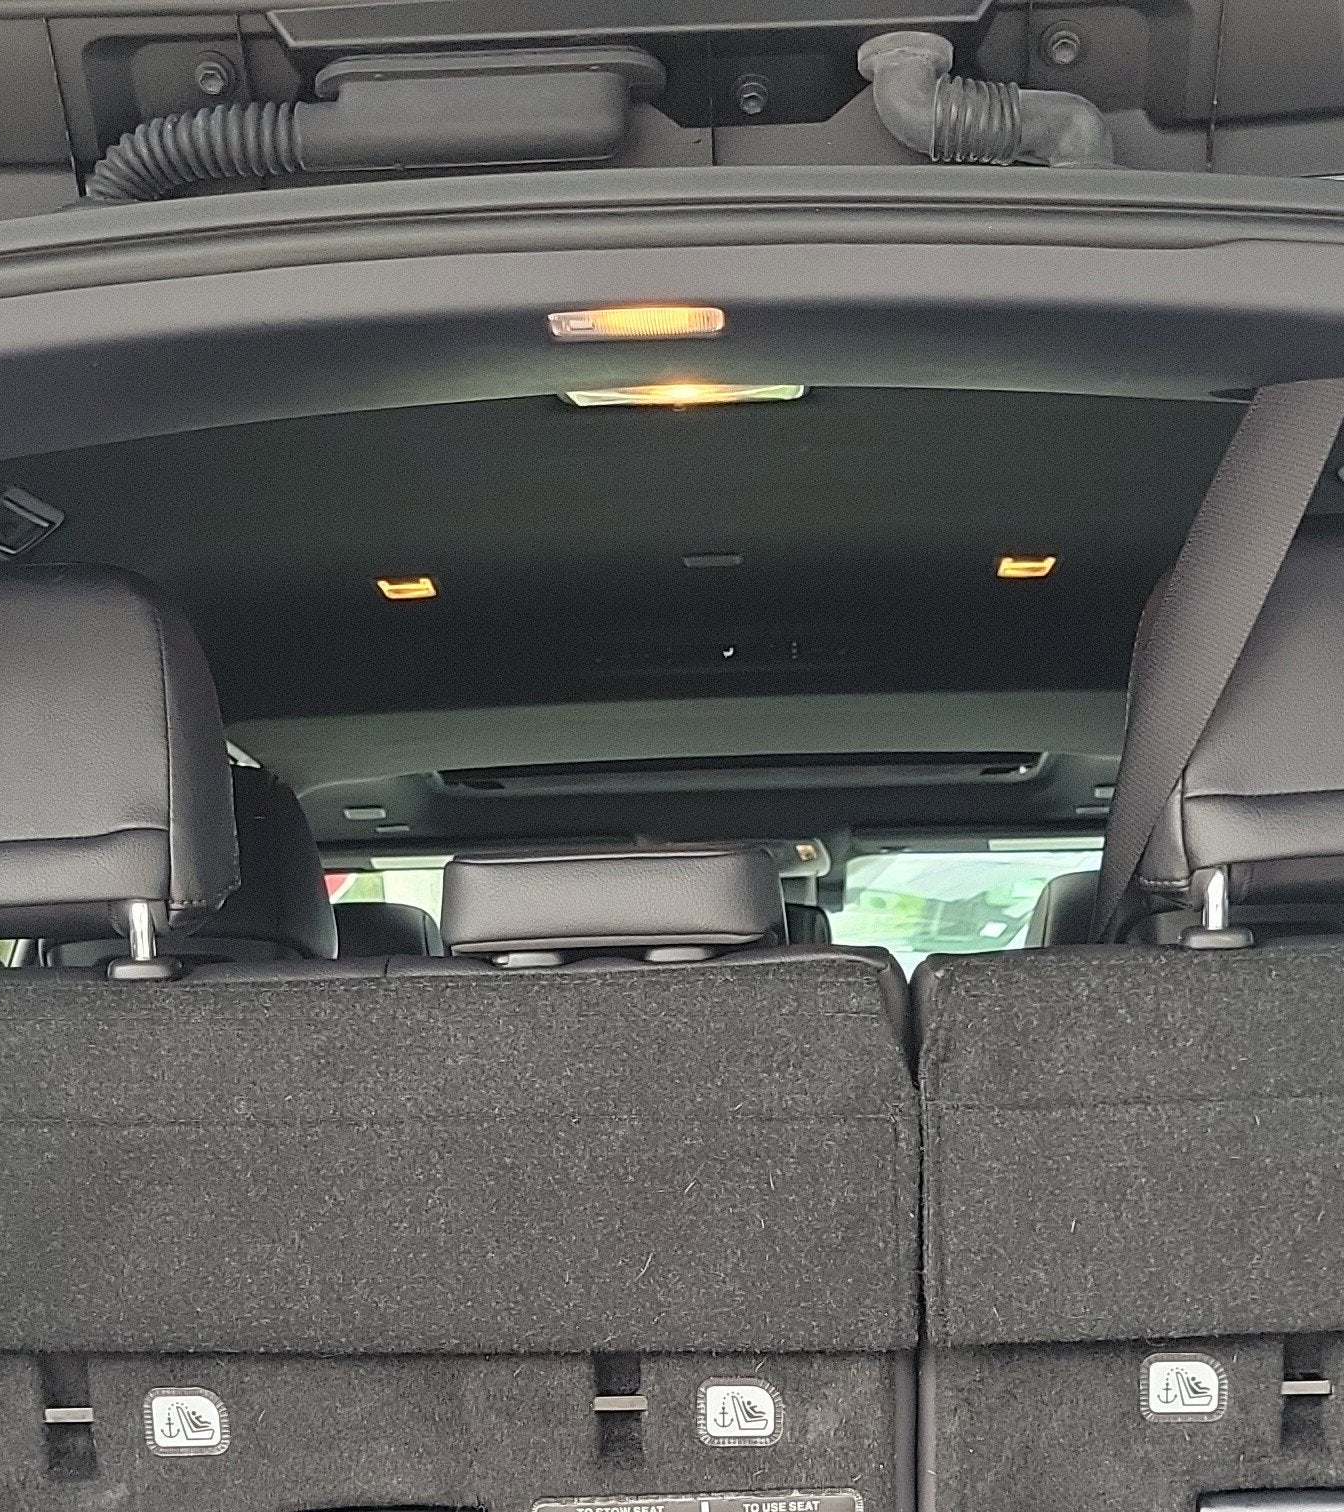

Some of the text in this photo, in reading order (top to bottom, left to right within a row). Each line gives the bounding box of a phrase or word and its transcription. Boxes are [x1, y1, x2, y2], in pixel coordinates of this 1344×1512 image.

[743, 1501, 820, 1512] TO USE SEAT
